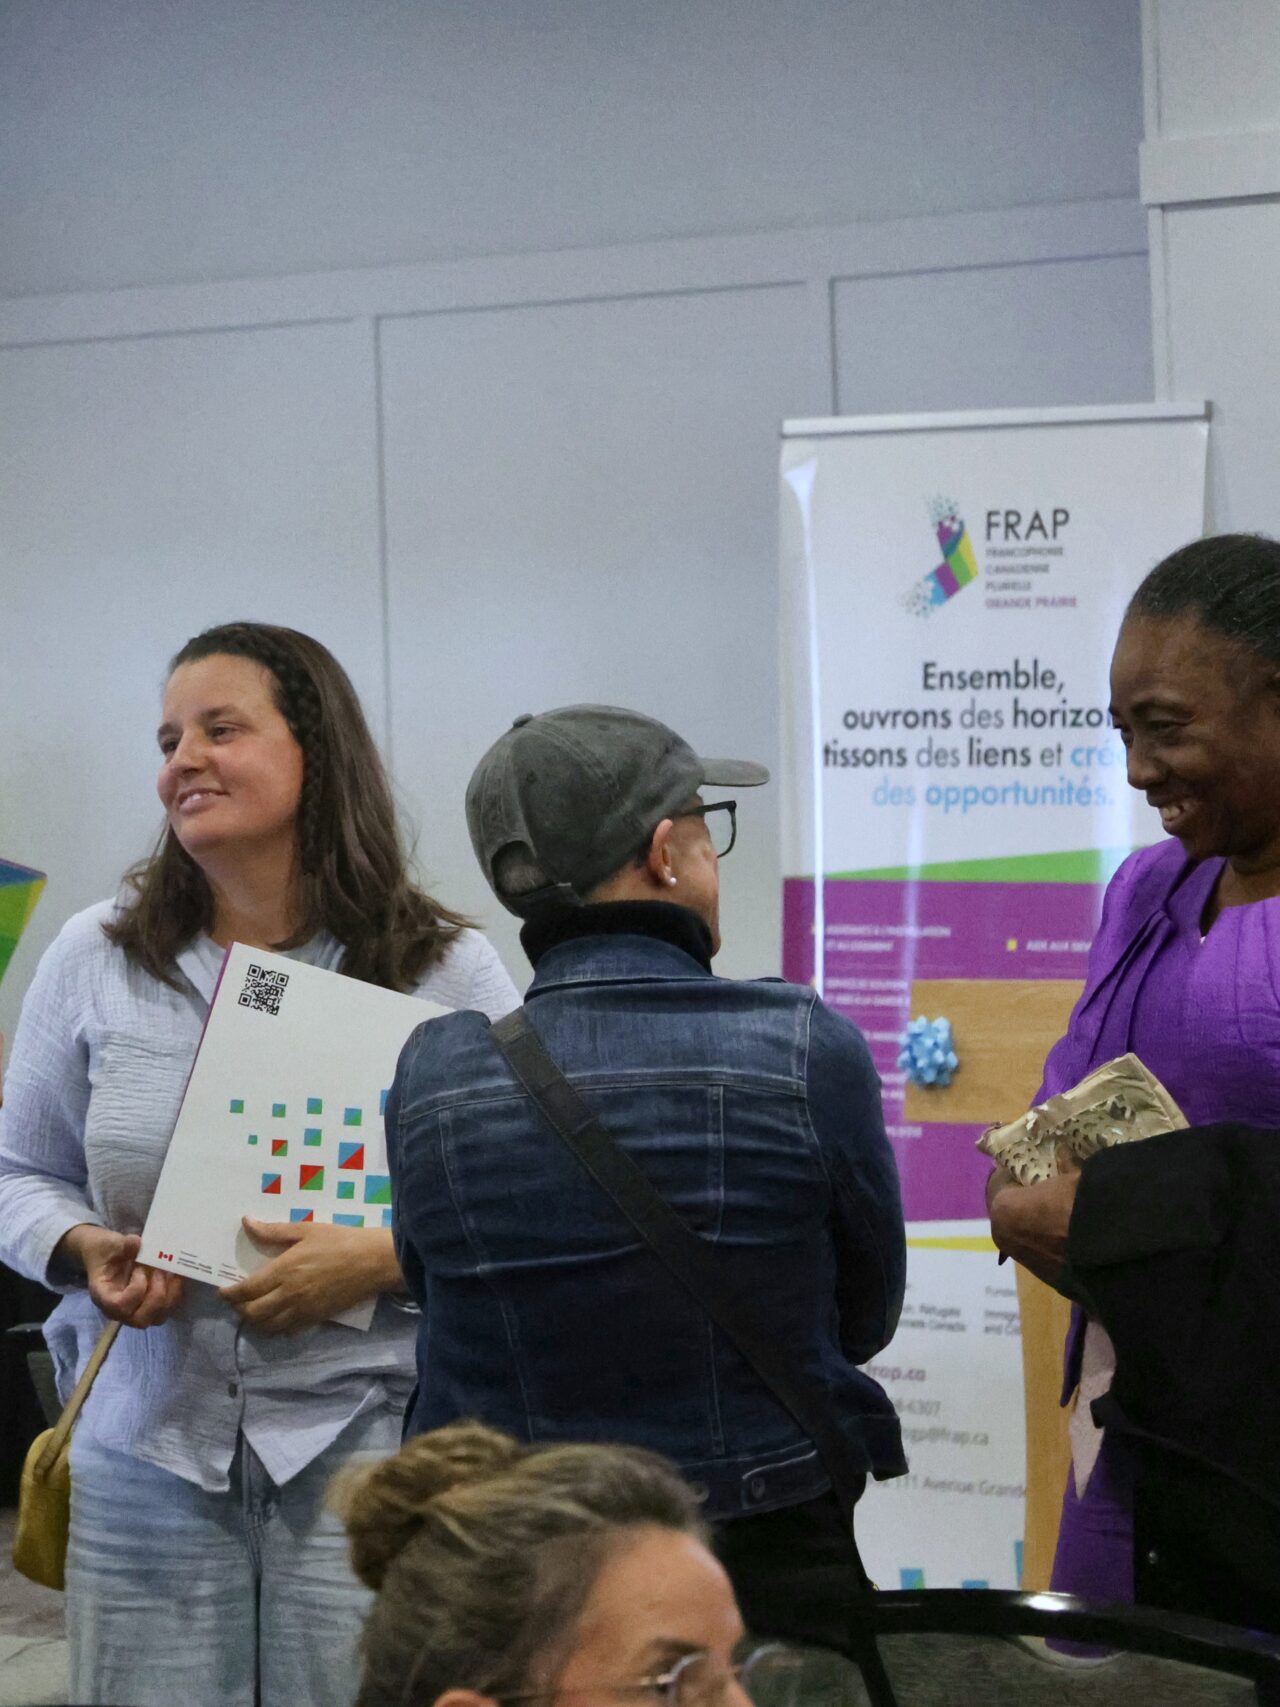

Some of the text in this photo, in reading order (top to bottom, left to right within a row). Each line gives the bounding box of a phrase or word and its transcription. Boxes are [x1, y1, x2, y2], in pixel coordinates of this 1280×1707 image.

[986, 508, 1070, 541] FRAP
[922, 658, 1065, 694] Ensemble,
[842, 707, 952, 730] ouvrons
[959, 698, 1004, 730] des
[823, 734, 1122, 768] tissons des liens et cré
[872, 775, 1114, 814] des opportunités.
[979, 1479, 1026, 1498] Grand
